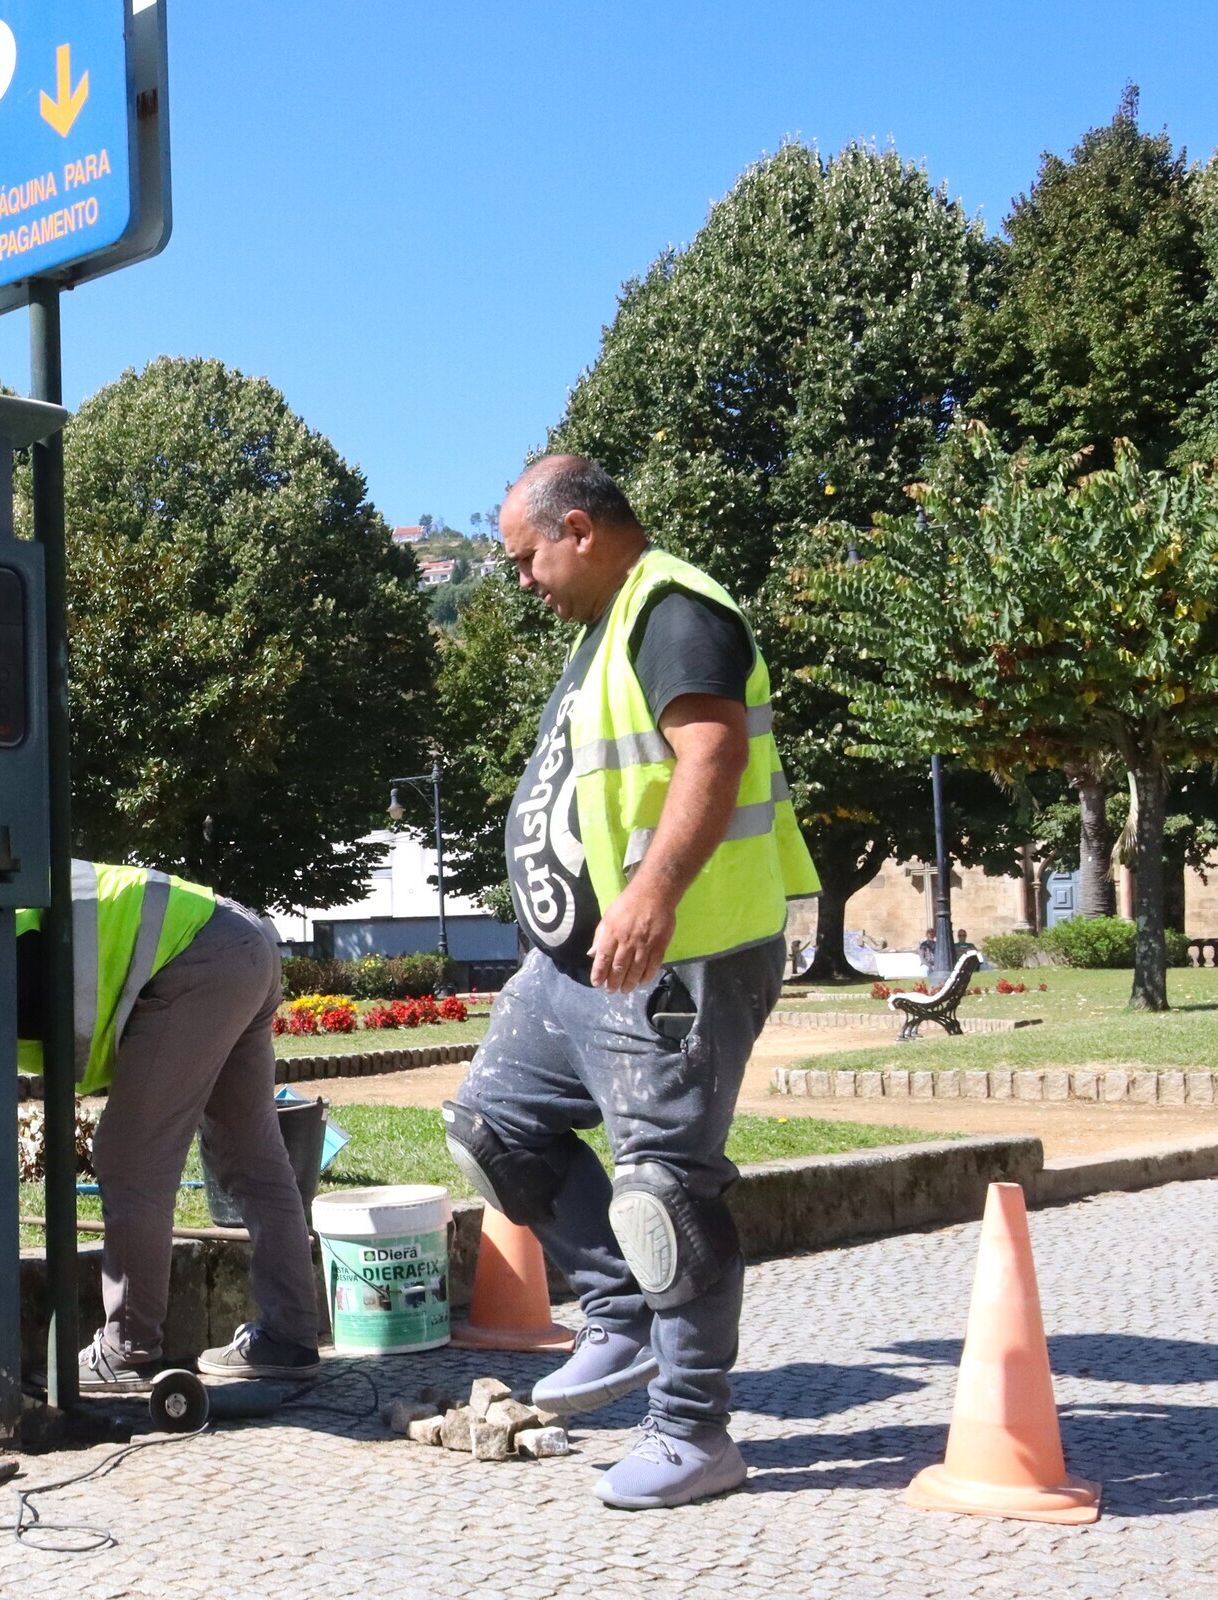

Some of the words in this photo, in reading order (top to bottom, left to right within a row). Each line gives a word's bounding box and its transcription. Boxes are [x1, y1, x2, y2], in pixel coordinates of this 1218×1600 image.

[64, 149, 110, 190] PARA
[377, 1248, 418, 1261] Diera
[363, 1260, 439, 1281] DIERAFIX
